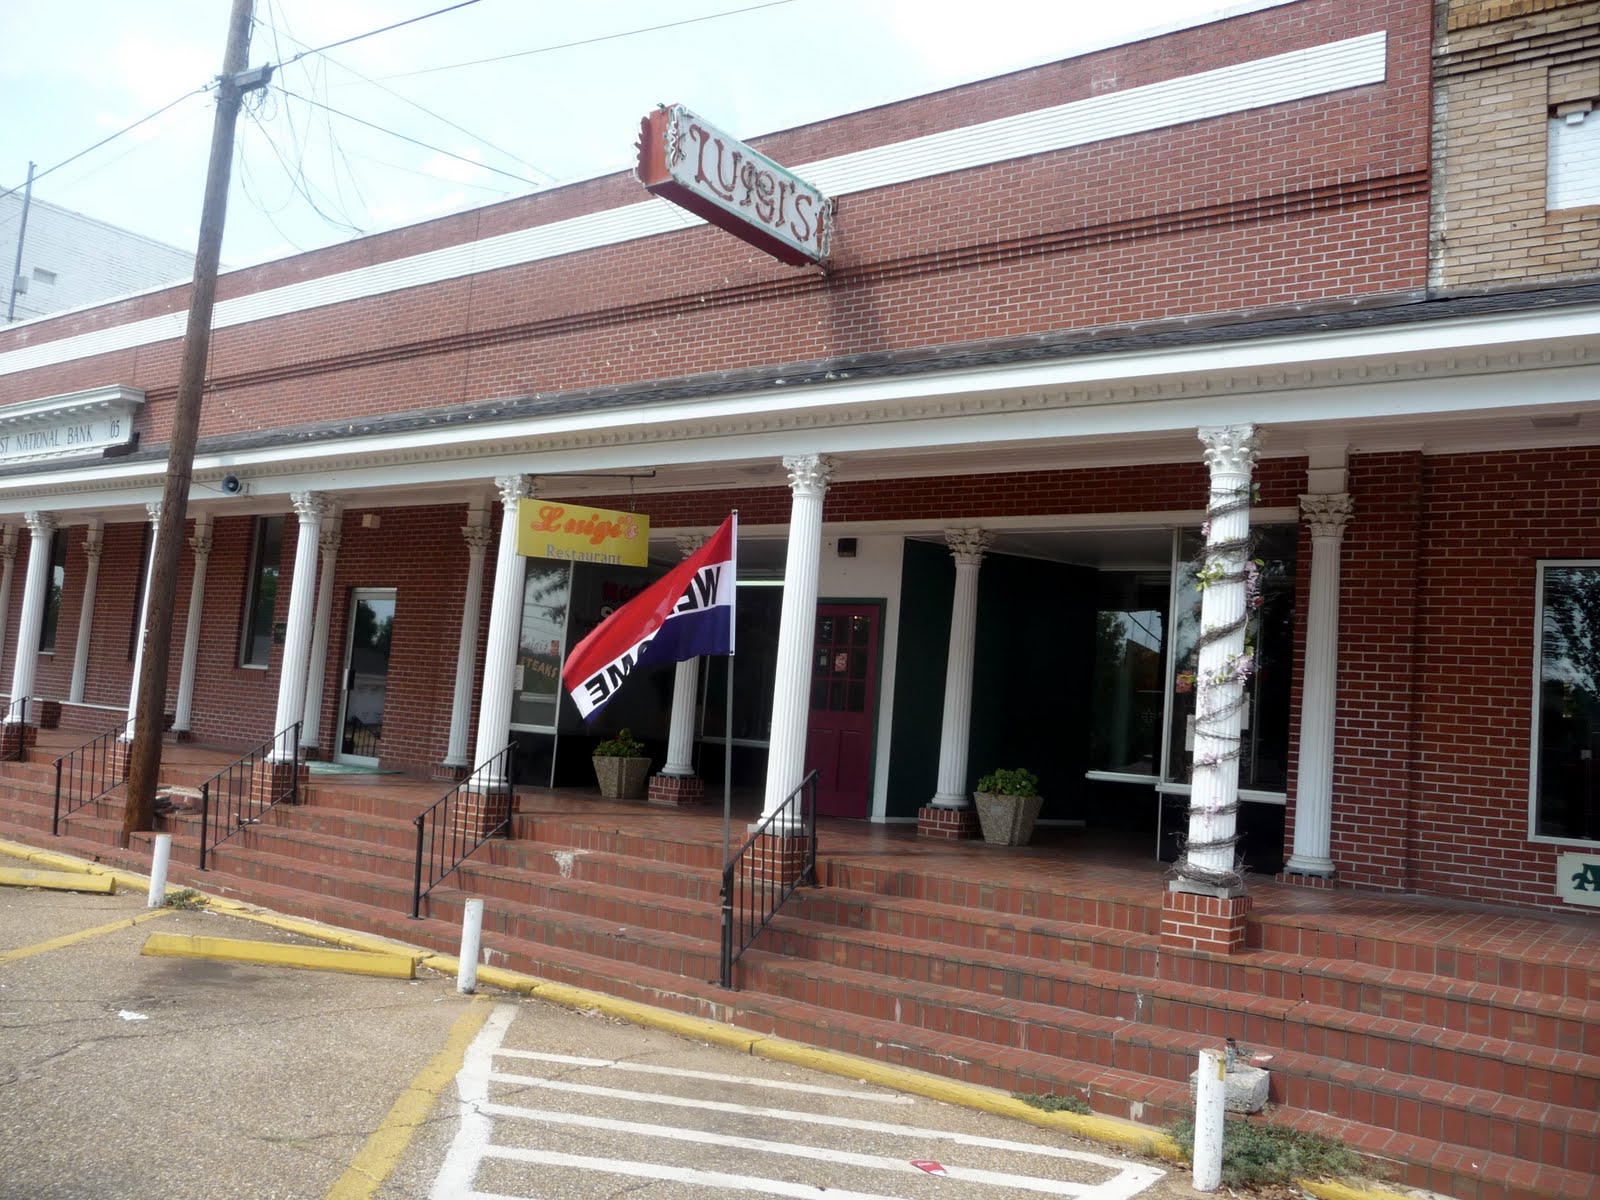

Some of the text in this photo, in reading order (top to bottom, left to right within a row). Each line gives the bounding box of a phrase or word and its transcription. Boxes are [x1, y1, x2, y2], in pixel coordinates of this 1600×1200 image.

[16, 429, 60, 451] NATIONAL
[67, 424, 93, 445] BANK
[531, 506, 638, 545] Luigi's
[546, 544, 622, 564] Restaurant
